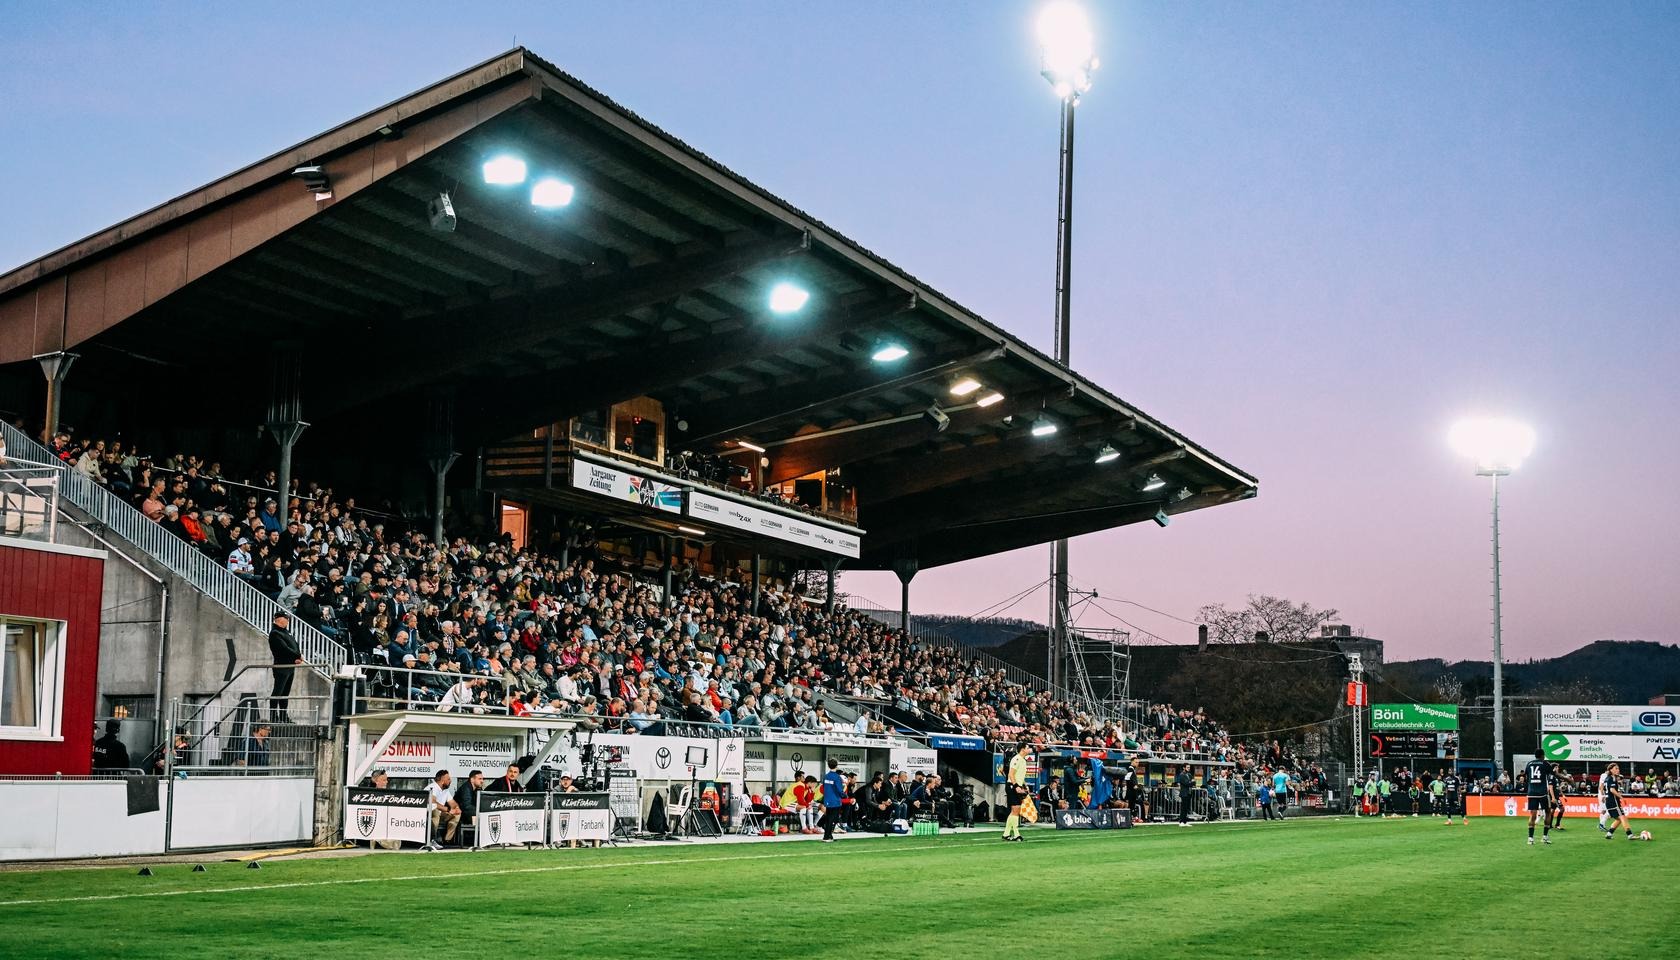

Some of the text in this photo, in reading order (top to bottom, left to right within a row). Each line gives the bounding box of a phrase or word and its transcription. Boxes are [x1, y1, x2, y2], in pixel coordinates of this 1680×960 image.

[590, 467, 616, 482] Aargauer
[589, 478, 612, 492] Zeitung
[1373, 709, 1404, 720] Böni
[449, 740, 512, 753] AUTO GERMANN
[1579, 738, 1606, 746] Energie.
[472, 760, 511, 768] HUNZENSCHWI
[906, 756, 935, 765] AUTO GERMANN
[1530, 766, 1541, 779] 14
[1623, 804, 1661, 817] gio-App
[390, 818, 426, 828] Fanbank
[580, 820, 605, 830] Fanbank
[1074, 815, 1092, 824] blue
[515, 820, 540, 832] Fanbank
